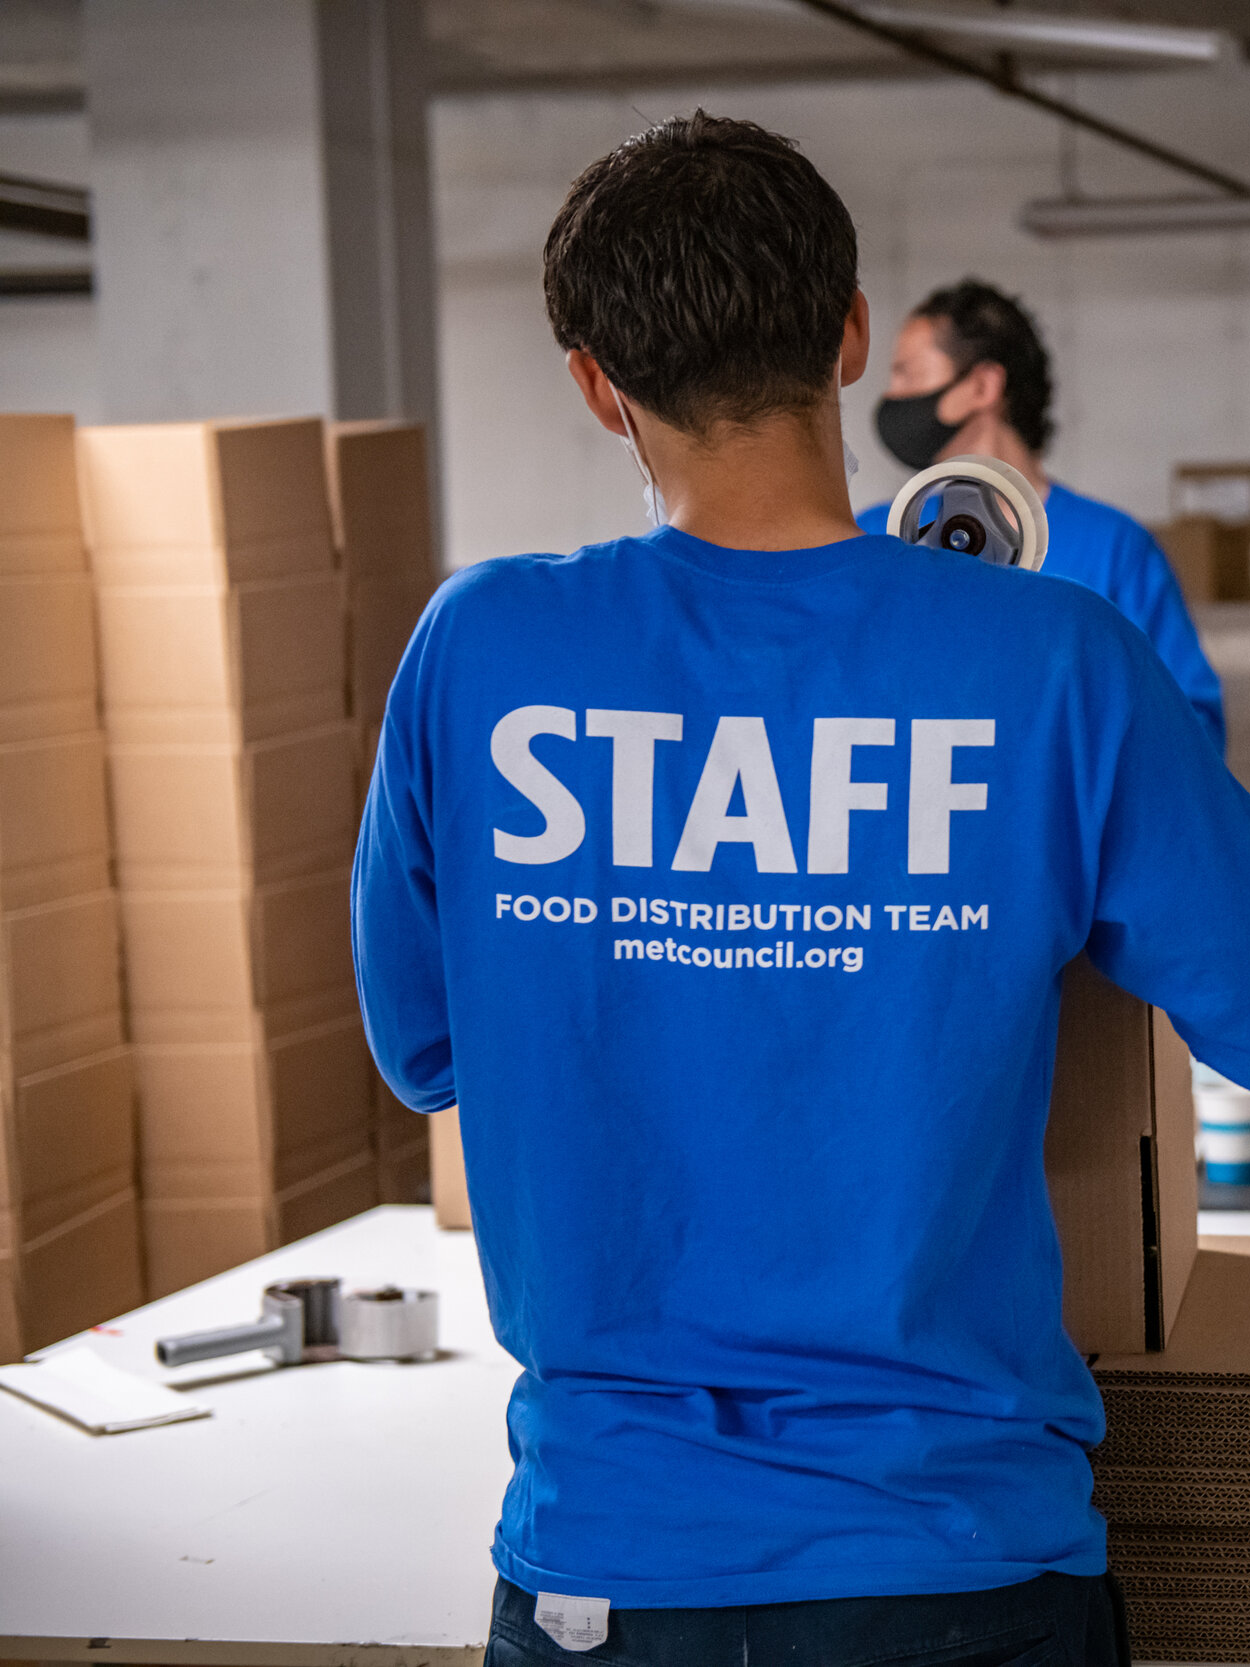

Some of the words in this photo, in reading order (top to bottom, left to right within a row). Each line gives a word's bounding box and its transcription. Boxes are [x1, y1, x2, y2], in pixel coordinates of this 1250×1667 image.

[490, 704, 996, 875] STAFF
[495, 893, 598, 924] FOOD
[611, 896, 872, 932] DISTRIBUTION
[883, 904, 989, 932] TEAM
[613, 936, 864, 973] metcouncil.org
